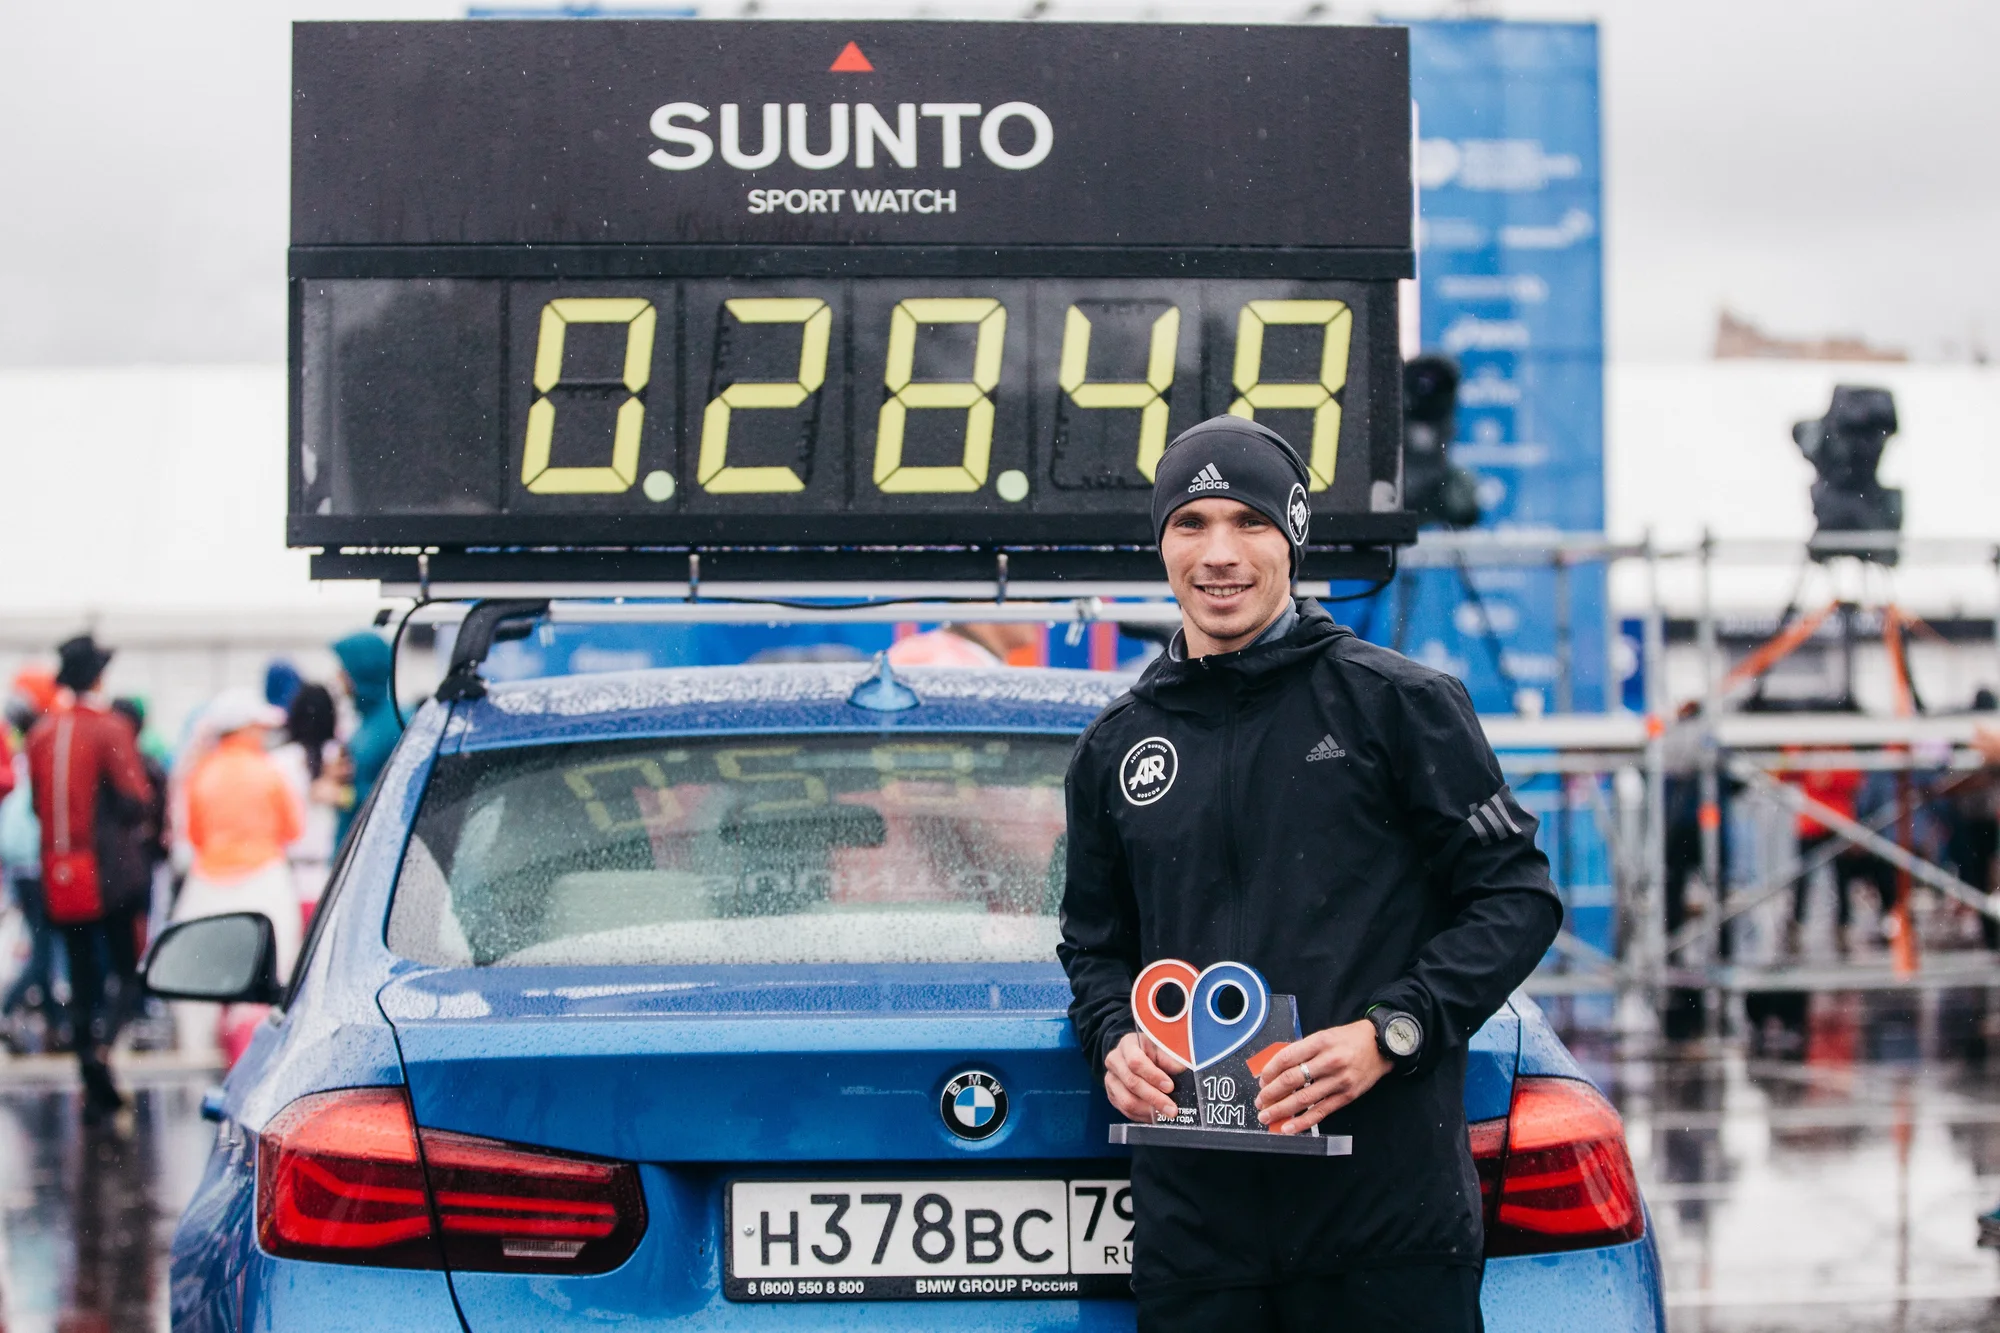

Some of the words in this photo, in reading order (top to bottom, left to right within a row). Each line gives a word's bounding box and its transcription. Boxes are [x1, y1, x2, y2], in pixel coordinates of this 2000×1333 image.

[647, 101, 1054, 171] SUUNTO
[747, 188, 846, 214] SPORT
[850, 188, 957, 214] WATCH
[1187, 479, 1230, 493] adidas
[1305, 749, 1346, 762] adidas
[947, 1074, 1003, 1097] BMW
[1202, 1076, 1236, 1102] 10
[747, 1281, 757, 1295] 8
[760, 1281, 794, 1296] (800)
[797, 1281, 823, 1295] 550
[826, 1281, 836, 1294] 8
[838, 1281, 865, 1294] 800
[916, 1279, 957, 1294] BMW
[958, 1278, 1018, 1293] GROUP
[1021, 1278, 1078, 1292] Россия
